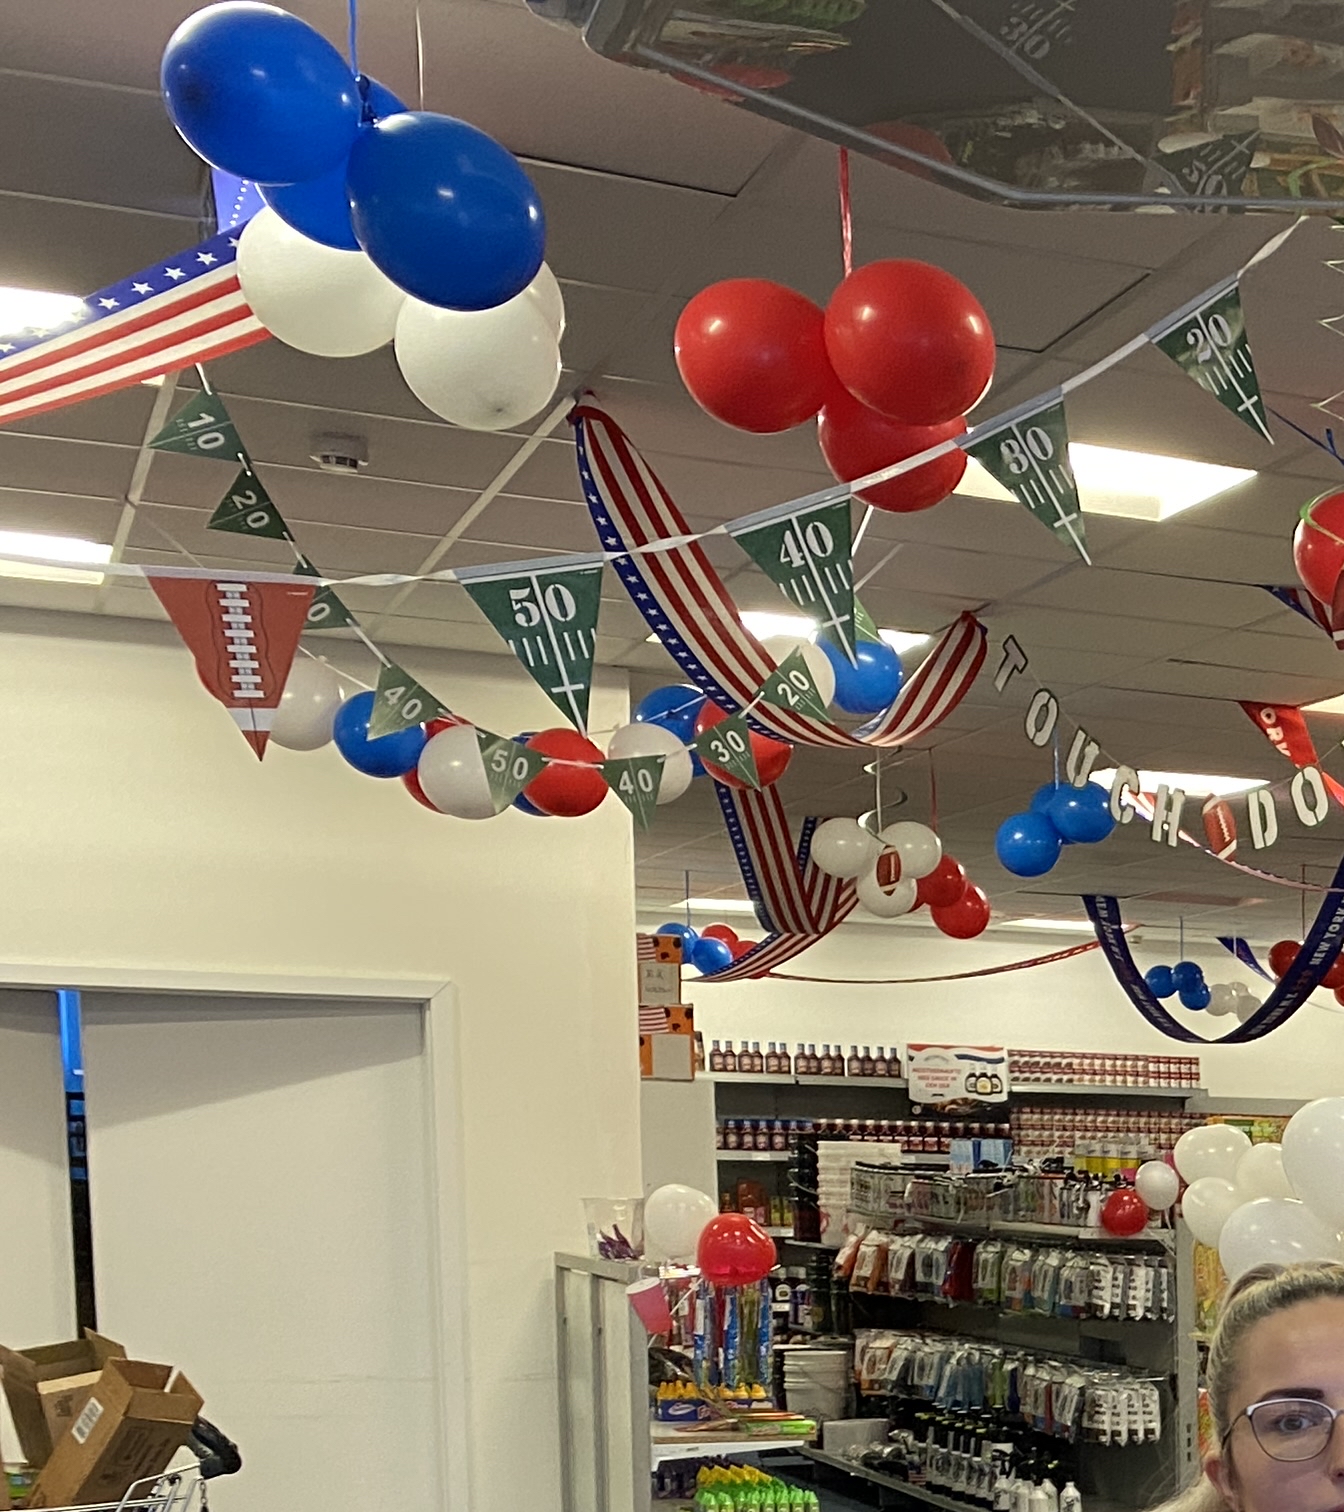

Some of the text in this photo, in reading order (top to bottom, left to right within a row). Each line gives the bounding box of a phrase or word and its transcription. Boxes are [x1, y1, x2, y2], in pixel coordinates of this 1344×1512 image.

[1186, 313, 1232, 363] 20
[187, 411, 225, 450] 10
[1000, 426, 1054, 474] 30
[231, 490, 270, 529] 20
[778, 521, 835, 569] 40
[509, 582, 577, 628] 50
[384, 684, 422, 720] 40
[777, 669, 811, 707] 20
[491, 750, 529, 781] 50
[710, 729, 746, 764] 30
[619, 768, 653, 796] 40
